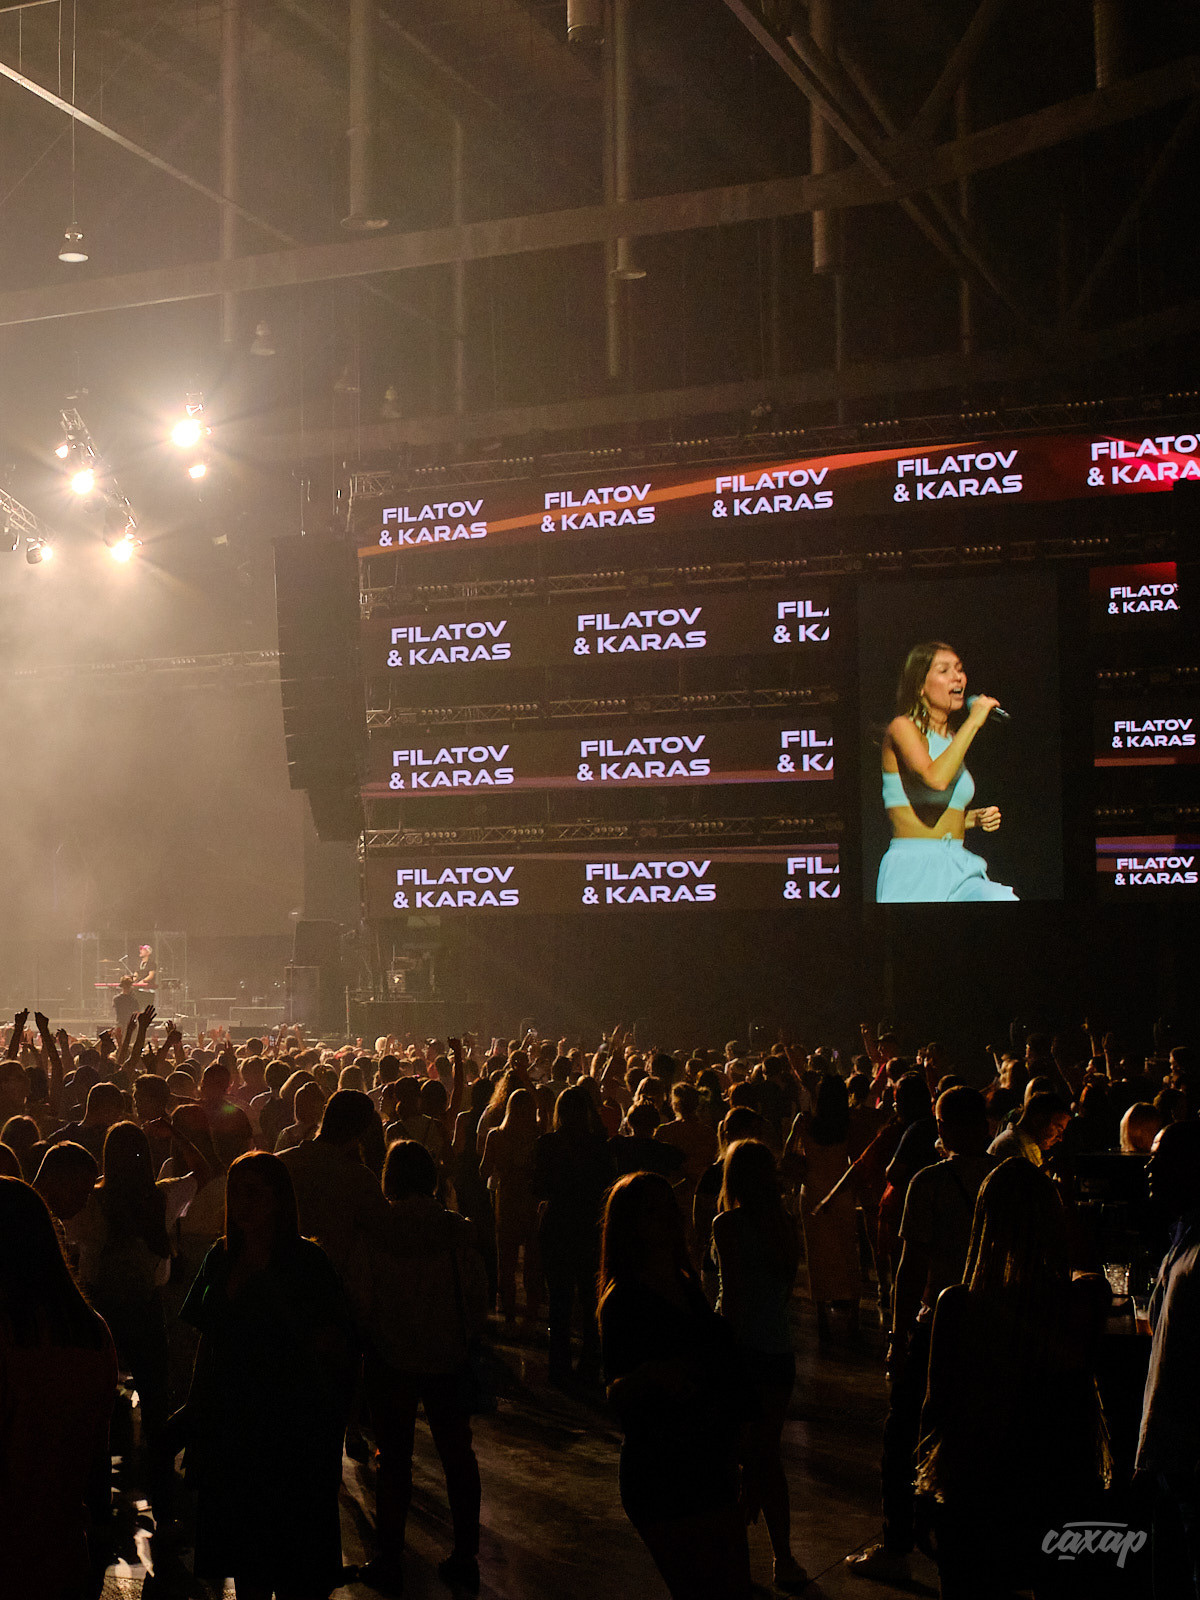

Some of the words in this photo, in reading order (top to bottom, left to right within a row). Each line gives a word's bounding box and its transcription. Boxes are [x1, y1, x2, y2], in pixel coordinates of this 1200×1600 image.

[1091, 434, 1200, 461] FILATO
[898, 450, 1017, 477] FILATOV
[716, 467, 828, 494] FILATOV
[1087, 467, 1104, 486] &
[545, 484, 651, 509] FILATOV
[894, 484, 910, 502] &
[917, 475, 1022, 500] KARAS
[383, 500, 483, 524] FILATOV
[712, 500, 727, 517] &
[734, 491, 833, 516] KARAS
[541, 515, 555, 532] &
[562, 507, 655, 530] KARAS
[379, 530, 392, 546] &
[399, 522, 487, 545] KARAS
[1110, 583, 1178, 599] FILATO
[778, 601, 829, 619] FIL
[1108, 602, 1118, 614] &
[578, 608, 702, 631] FILATOV
[392, 621, 507, 644] FILATOV
[773, 625, 791, 643] &
[574, 638, 590, 655] &
[598, 631, 706, 653] KARAS
[387, 650, 402, 666] &
[410, 643, 511, 665] KARAS
[1115, 719, 1192, 732] FILATOV
[581, 735, 705, 757] FILATOV
[781, 730, 833, 748] FIL
[1112, 736, 1123, 748] &
[1127, 734, 1195, 747] KARAS
[393, 745, 509, 766] FILATOV
[777, 754, 795, 772] &
[389, 773, 404, 789] &
[412, 768, 514, 788] KARAS
[577, 764, 594, 781] &
[601, 759, 710, 780] KARAS
[586, 861, 711, 880] FILATOV
[787, 857, 839, 874] FIL
[1117, 856, 1194, 870] FILATOV
[397, 867, 514, 885] FILATOV
[1115, 873, 1125, 885] &
[1130, 872, 1198, 885] KARAS
[393, 892, 409, 908] &
[416, 890, 519, 908] KARAS
[582, 887, 599, 904] &
[606, 884, 716, 903] KARAS
[783, 881, 801, 899] &
